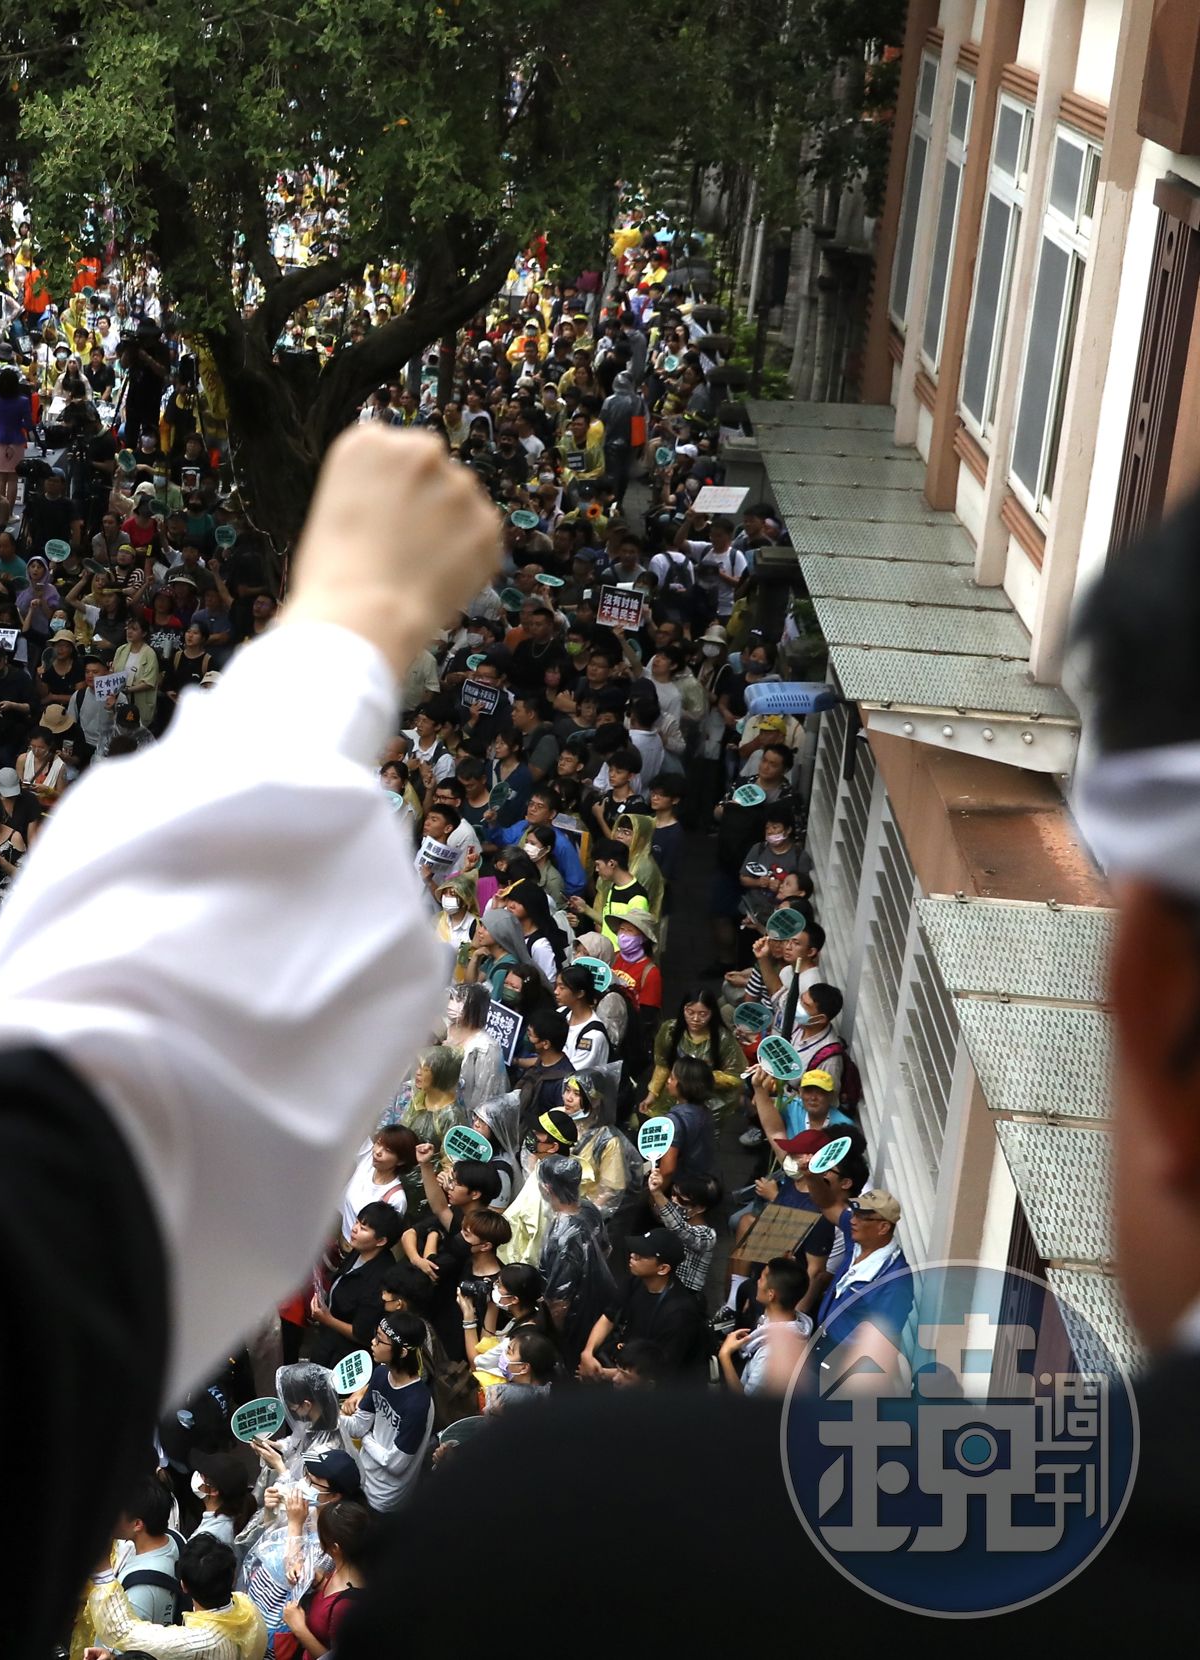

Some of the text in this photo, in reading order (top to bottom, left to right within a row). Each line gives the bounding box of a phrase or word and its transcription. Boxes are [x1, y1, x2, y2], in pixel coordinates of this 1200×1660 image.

[603, 593, 640, 610] 沒有討論
[601, 605, 638, 622] 不是民主
